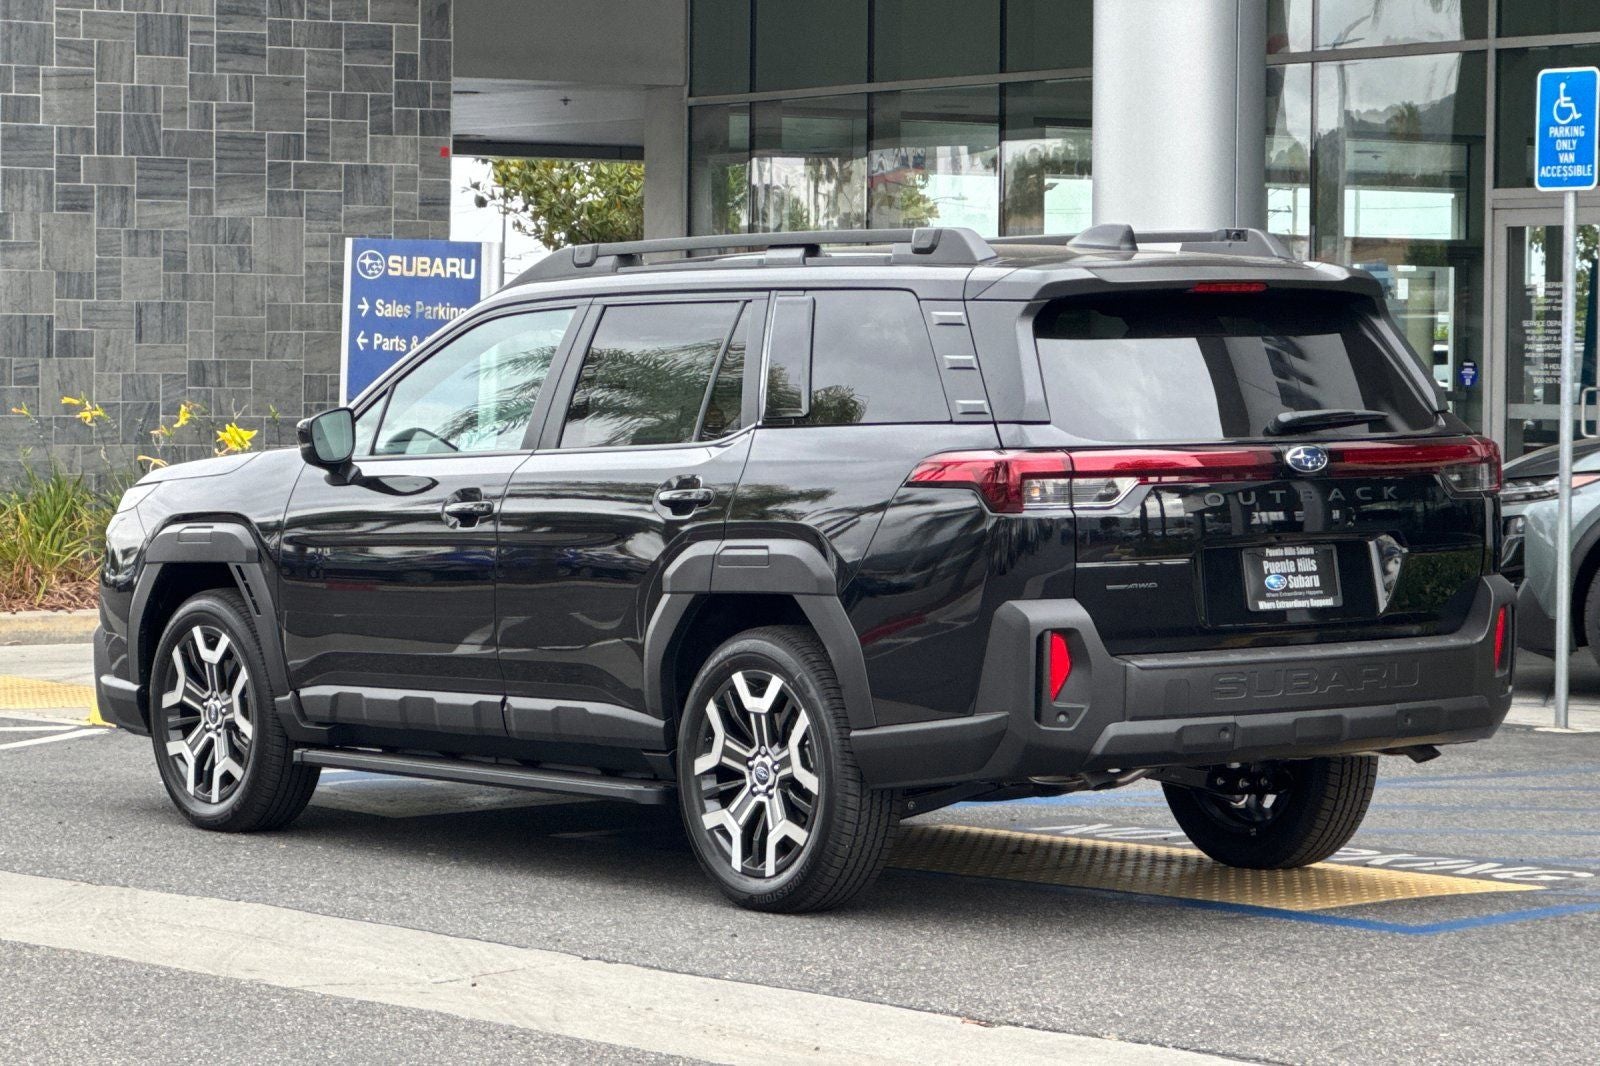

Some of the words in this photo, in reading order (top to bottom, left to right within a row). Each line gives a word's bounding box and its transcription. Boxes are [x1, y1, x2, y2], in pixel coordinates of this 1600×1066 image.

[1549, 126, 1585, 137] PARKING
[1556, 139, 1577, 150] ONLY
[1558, 152, 1575, 163] VAN
[1540, 164, 1592, 177] ACCESSIBLE
[387, 255, 476, 279] SUBARU
[375, 299, 411, 318] Sales
[374, 333, 406, 351] Parts
[1204, 486, 1398, 506] OUTBACK
[1263, 560, 1295, 574] Puente
[1297, 558, 1317, 572] Hills
[1288, 575, 1320, 588] Subaru
[1258, 601, 1276, 610] Where
[1213, 661, 1421, 701] SUBARU
